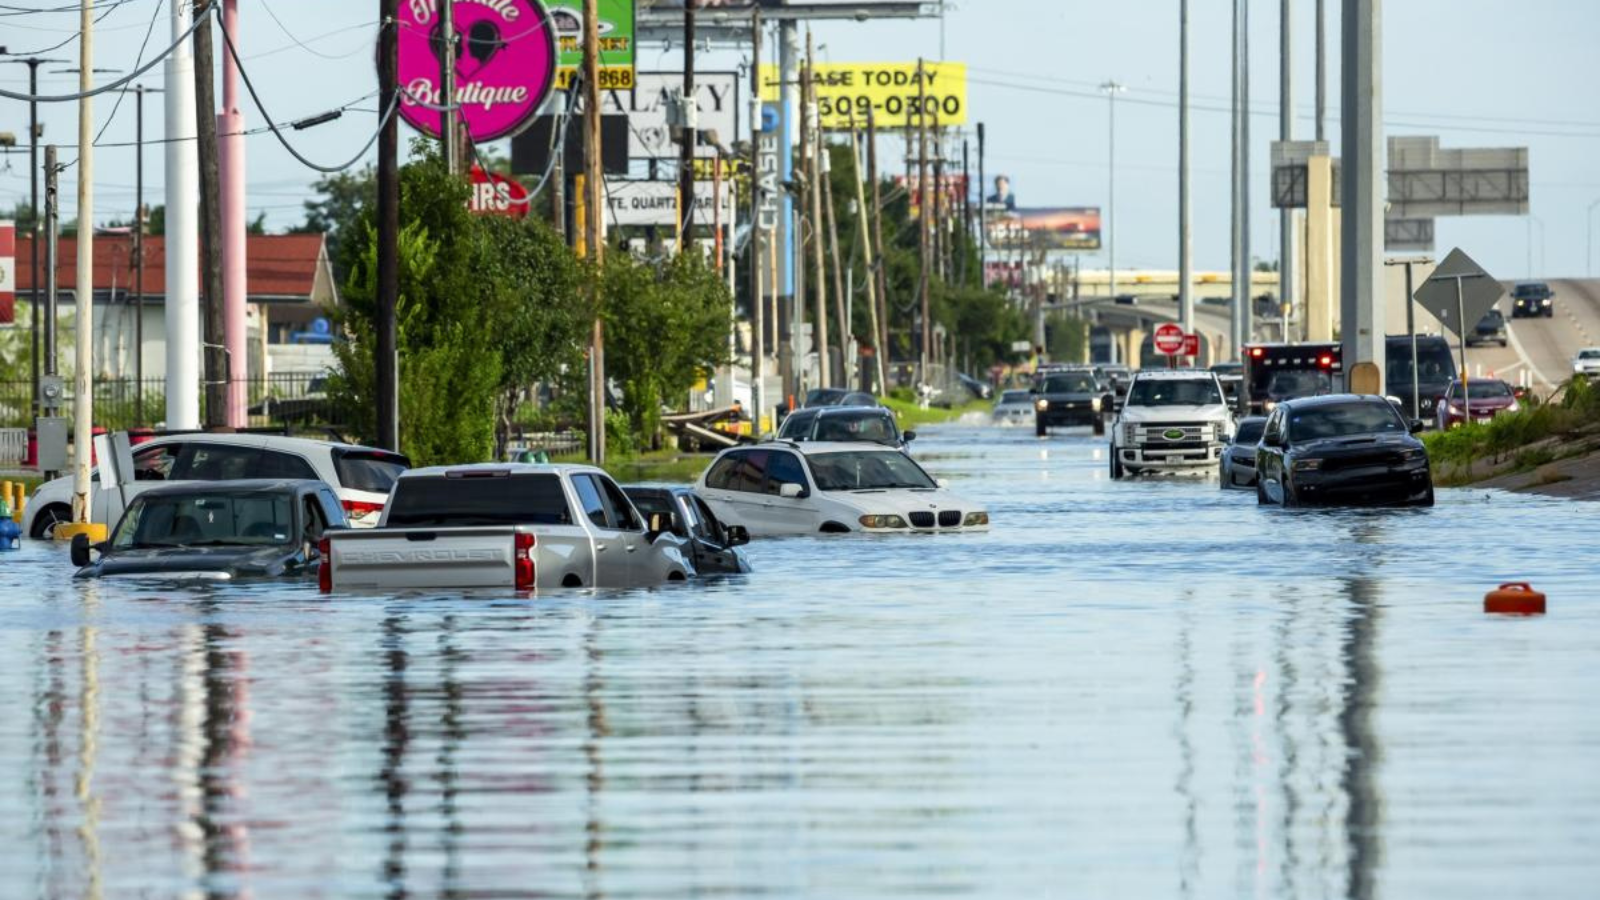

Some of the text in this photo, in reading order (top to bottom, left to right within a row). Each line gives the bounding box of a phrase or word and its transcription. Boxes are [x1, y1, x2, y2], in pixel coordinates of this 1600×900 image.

[560, 36, 629, 52] PLNET
[813, 71, 938, 86] ASE TODAY
[758, 135, 779, 230] CHASE
[471, 182, 511, 211] IRS
[342, 548, 503, 562] CHEVROLET
